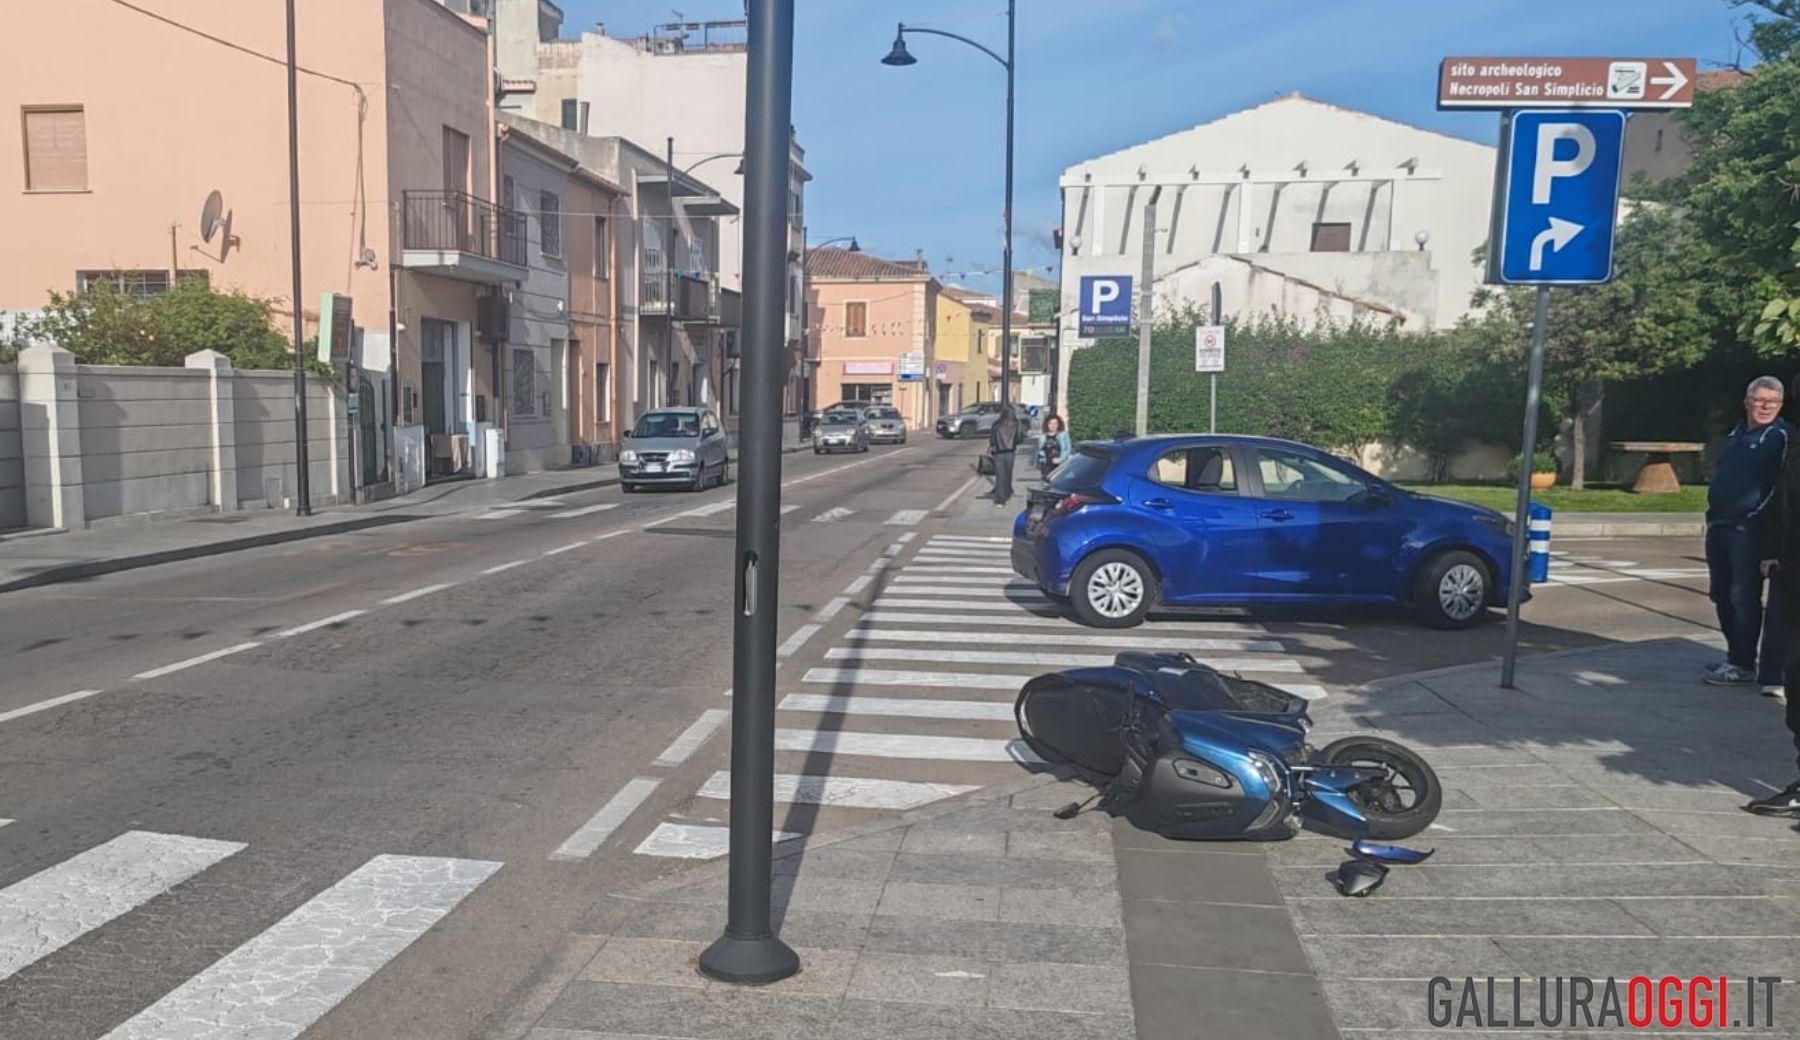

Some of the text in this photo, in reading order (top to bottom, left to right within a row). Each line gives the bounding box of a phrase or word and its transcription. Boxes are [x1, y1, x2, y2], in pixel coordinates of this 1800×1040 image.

[1451, 63, 1562, 79] sito archeologico
[1449, 82, 1604, 98] Necropoli San Simplicio
[1532, 123, 1597, 205] P
[1092, 280, 1119, 314] P
[1082, 314, 1095, 322] San
